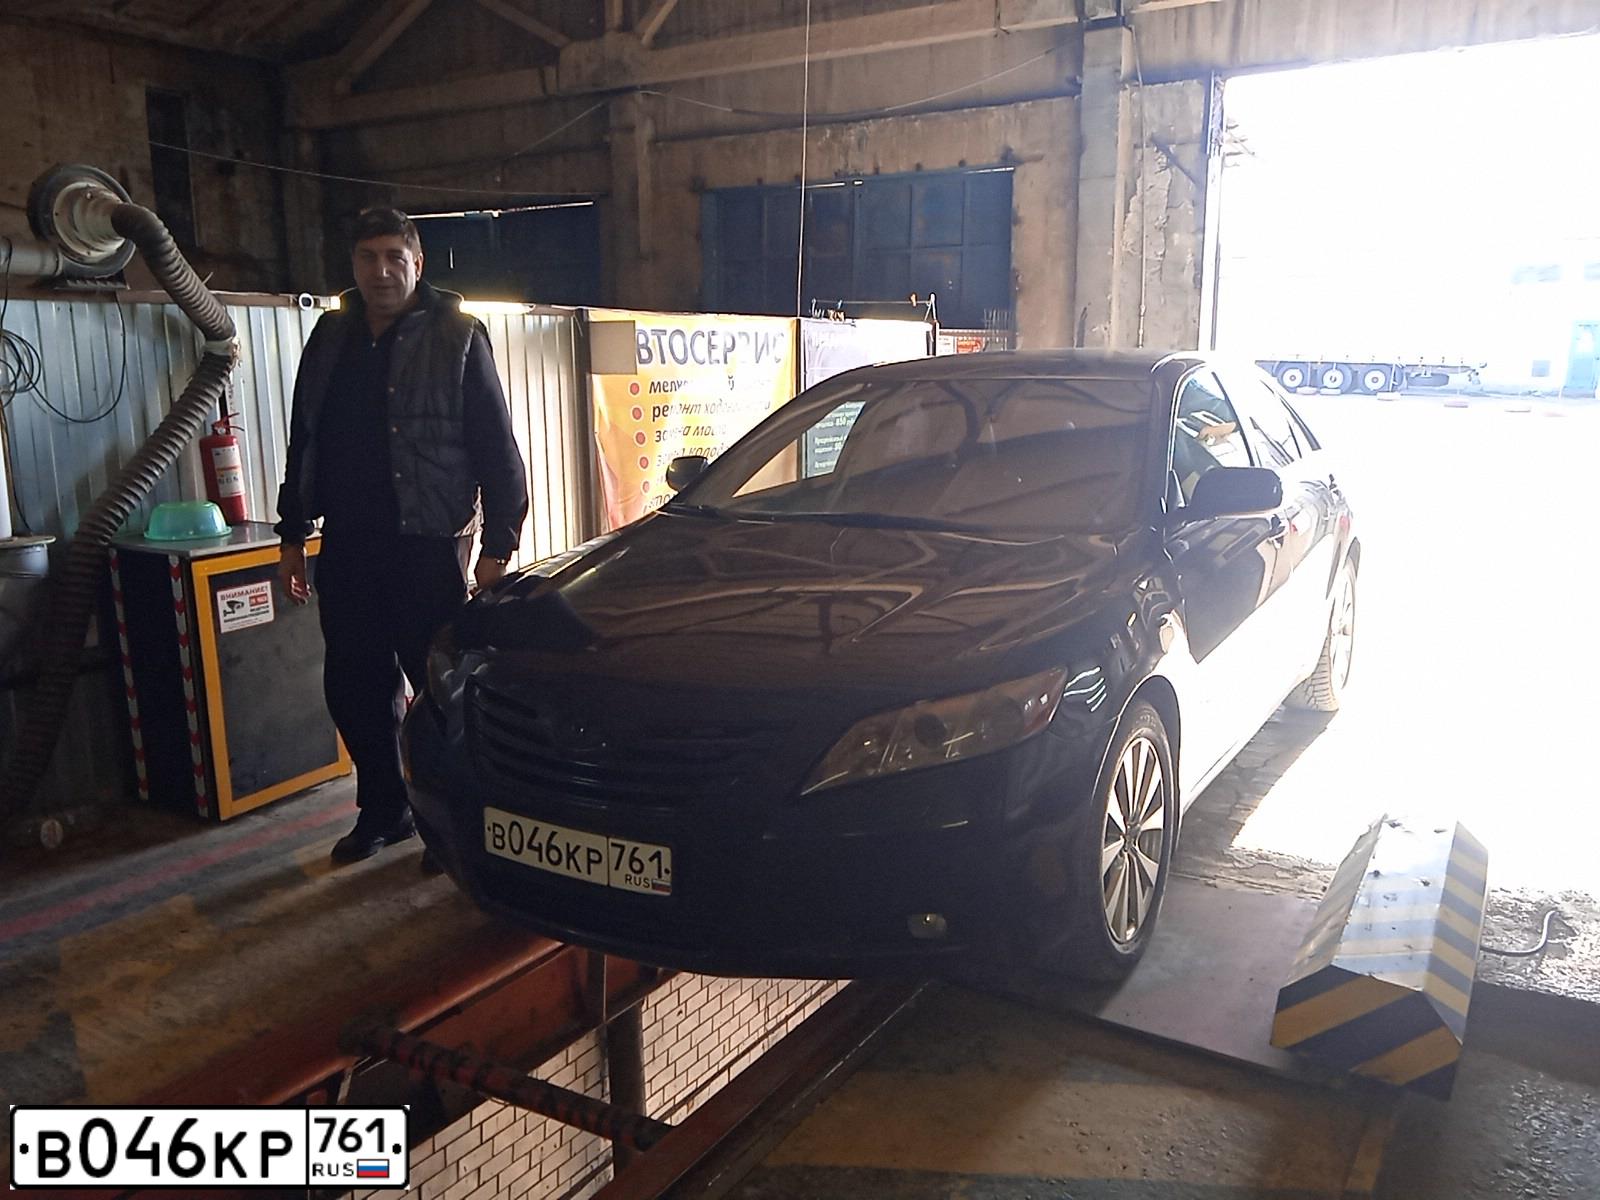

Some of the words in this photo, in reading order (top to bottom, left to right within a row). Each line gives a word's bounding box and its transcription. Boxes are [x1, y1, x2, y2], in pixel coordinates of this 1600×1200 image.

[636, 328, 785, 366] ВТОСЕРИС
[220, 585, 268, 601] ВНИМАНИЕ!
[492, 821, 603, 875] В046КР
[610, 842, 662, 879] 761
[625, 873, 651, 889] RUS
